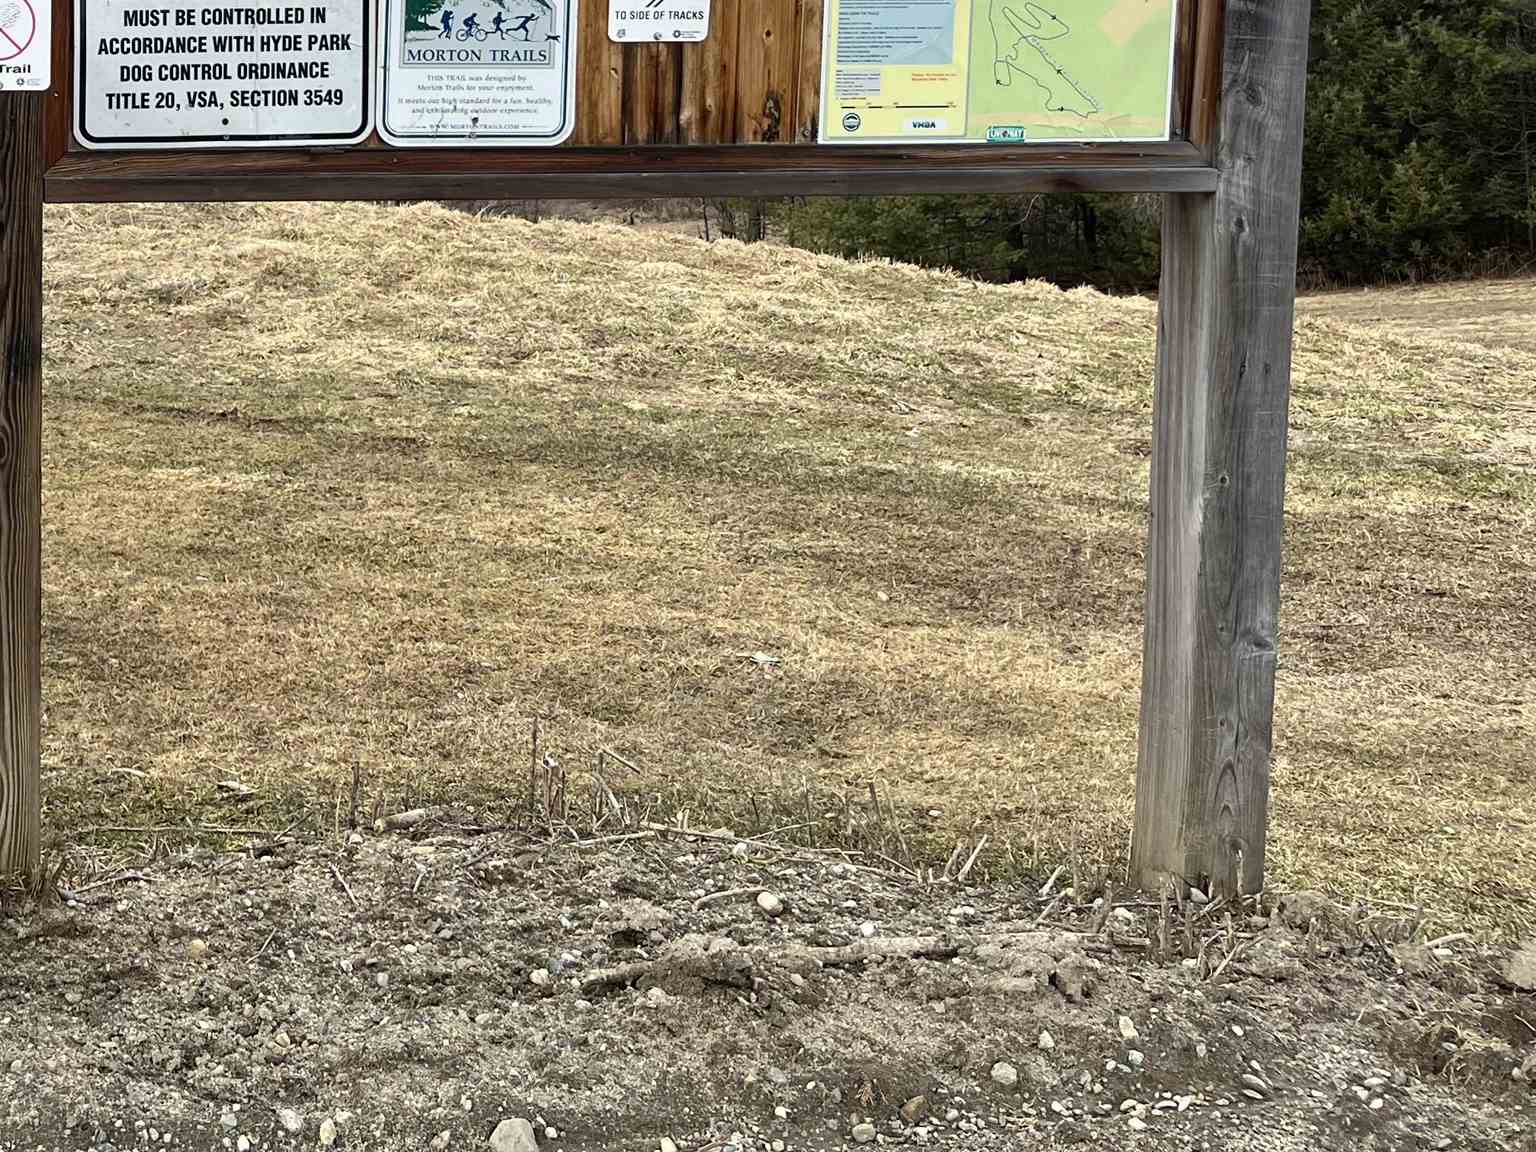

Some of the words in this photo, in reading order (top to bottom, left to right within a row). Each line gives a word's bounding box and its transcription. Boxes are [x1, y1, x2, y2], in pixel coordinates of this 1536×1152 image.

[124, 10, 170, 26] MUST
[176, 9, 196, 26] BE
[202, 8, 304, 25] CONTROLLED
[310, 8, 326, 24] IN
[616, 11, 626, 19] TO
[630, 11, 650, 19] SIDE
[653, 11, 665, 19] OF
[669, 11, 704, 19] TRACKS
[98, 37, 207, 55] ACCORDANCE
[213, 36, 255, 52] WITH
[260, 35, 302, 52] HYDE
[308, 34, 352, 50] PARK
[407, 49, 481, 61] MORTON
[490, 50, 547, 61] TRAILS
[120, 65, 152, 82] DOG
[158, 64, 232, 80] CONTROL
[238, 62, 329, 80] ORDINANCE
[106, 92, 150, 110] TITLE
[155, 92, 181, 111] 20,
[187, 91, 224, 110] VSA,
[230, 90, 298, 108] SECTION
[304, 89, 343, 106] 3549
